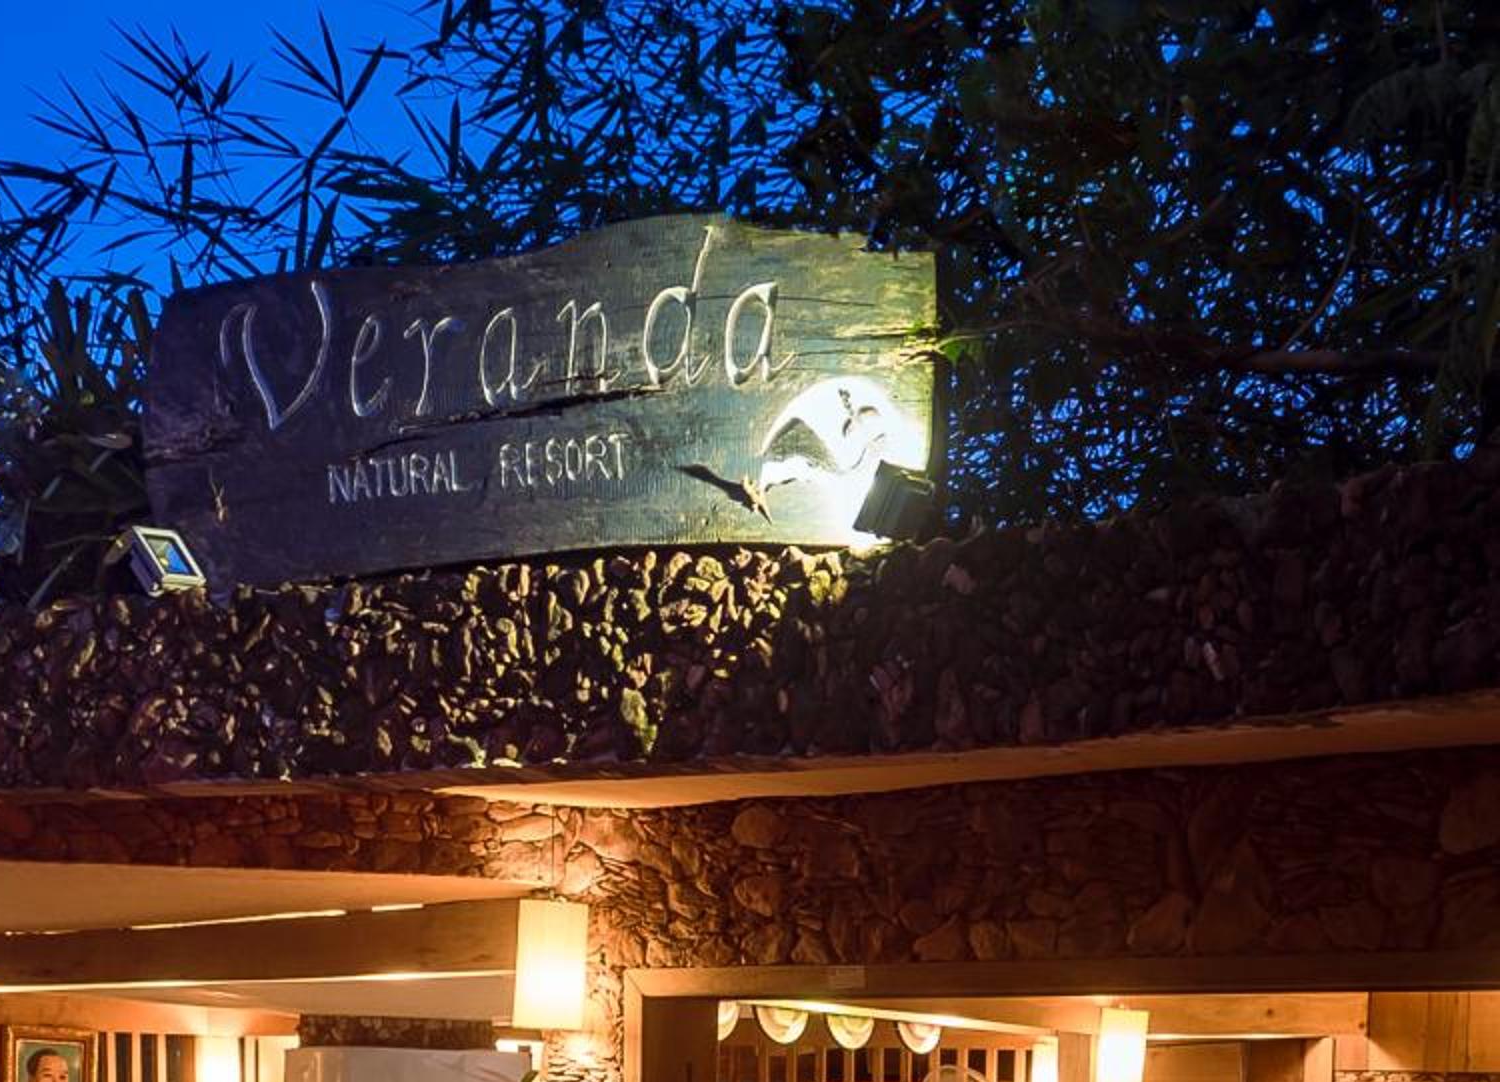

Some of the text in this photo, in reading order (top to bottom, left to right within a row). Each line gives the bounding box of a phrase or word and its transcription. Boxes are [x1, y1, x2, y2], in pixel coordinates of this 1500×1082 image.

[219, 225, 797, 430] Veranda
[327, 432, 630, 505] NATURAL RESORT
